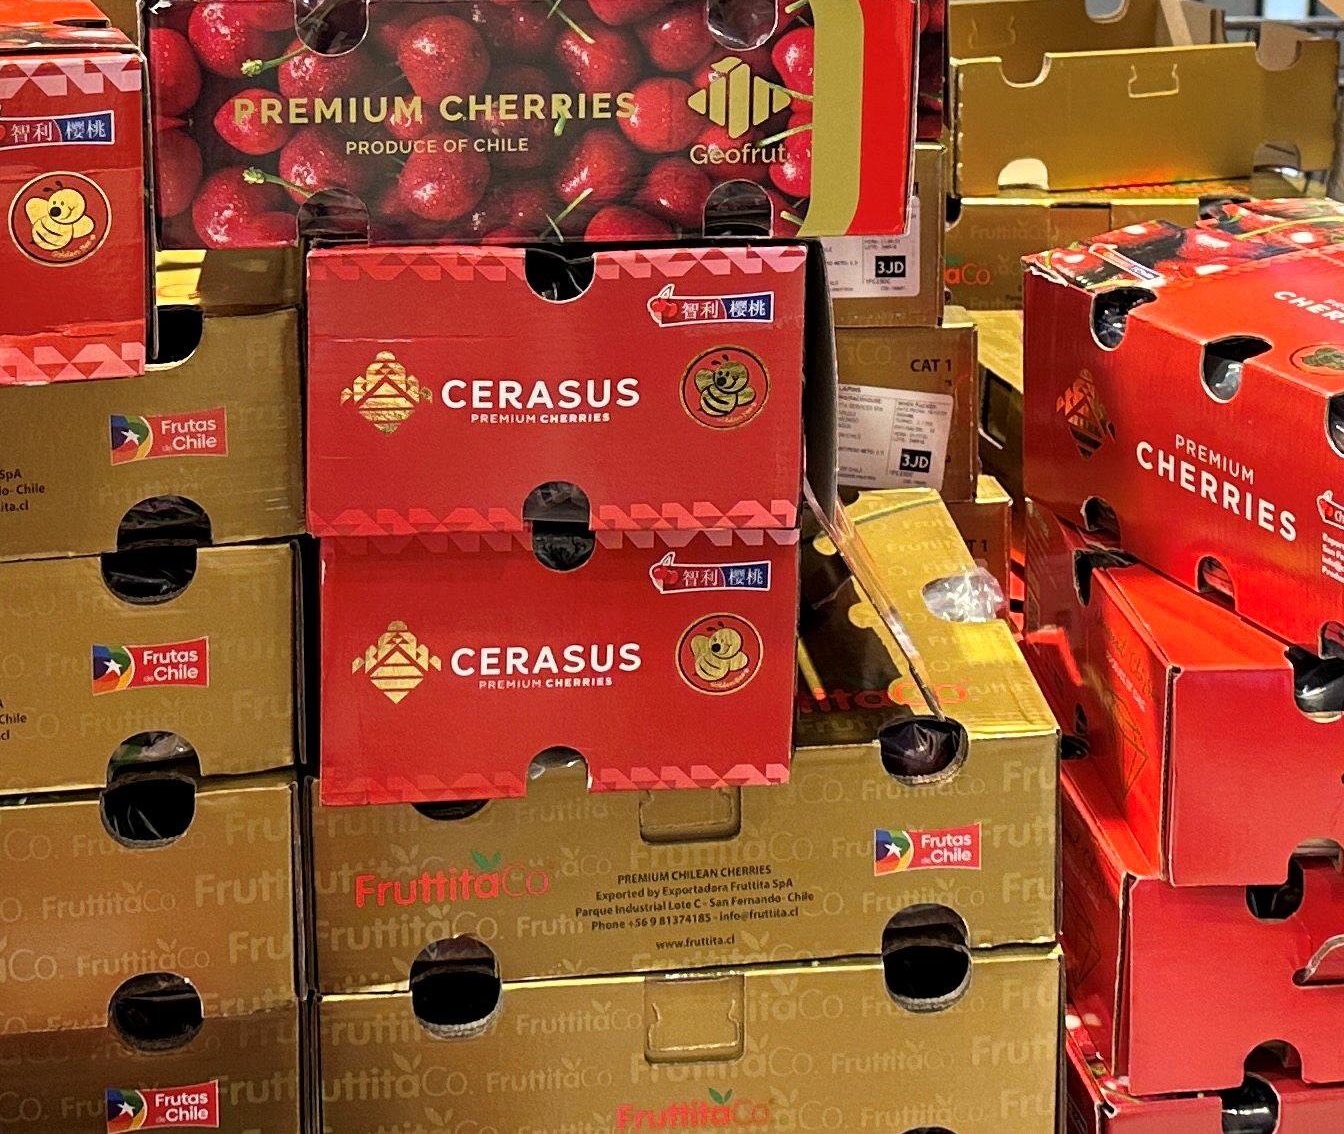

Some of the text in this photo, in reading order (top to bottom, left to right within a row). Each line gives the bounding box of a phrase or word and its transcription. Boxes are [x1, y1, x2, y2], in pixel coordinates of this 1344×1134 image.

[232, 92, 636, 125] PREMIUM CHERRIES
[9, 120, 54, 145] 智利
[345, 136, 529, 156] PRODUCE OF CHILE
[689, 143, 787, 166] Geofrut
[877, 261, 904, 274] 3JD
[680, 300, 720, 321] 智利
[911, 358, 952, 373] CAT 1
[441, 378, 641, 410] CERASUS
[470, 412, 611, 425] PREMIUM CHERRIES
[161, 419, 216, 435] Frutas
[173, 434, 217, 450] Chile
[901, 454, 929, 470] 3JD
[1175, 434, 1255, 485] PREMIUM
[16, 482, 46, 496] Chile
[1136, 441, 1297, 543] CHERRIES
[681, 568, 719, 588] 智利
[143, 649, 198, 665] Frutas
[450, 643, 642, 677] CERASUS
[154, 665, 199, 681] Chile
[478, 677, 613, 690] PREMIUM CHERRIES
[921, 834, 972, 848] Frutas
[931, 849, 972, 863] Chile
[154, 1091, 209, 1107] Frutas
[165, 1106, 210, 1123] Chile
